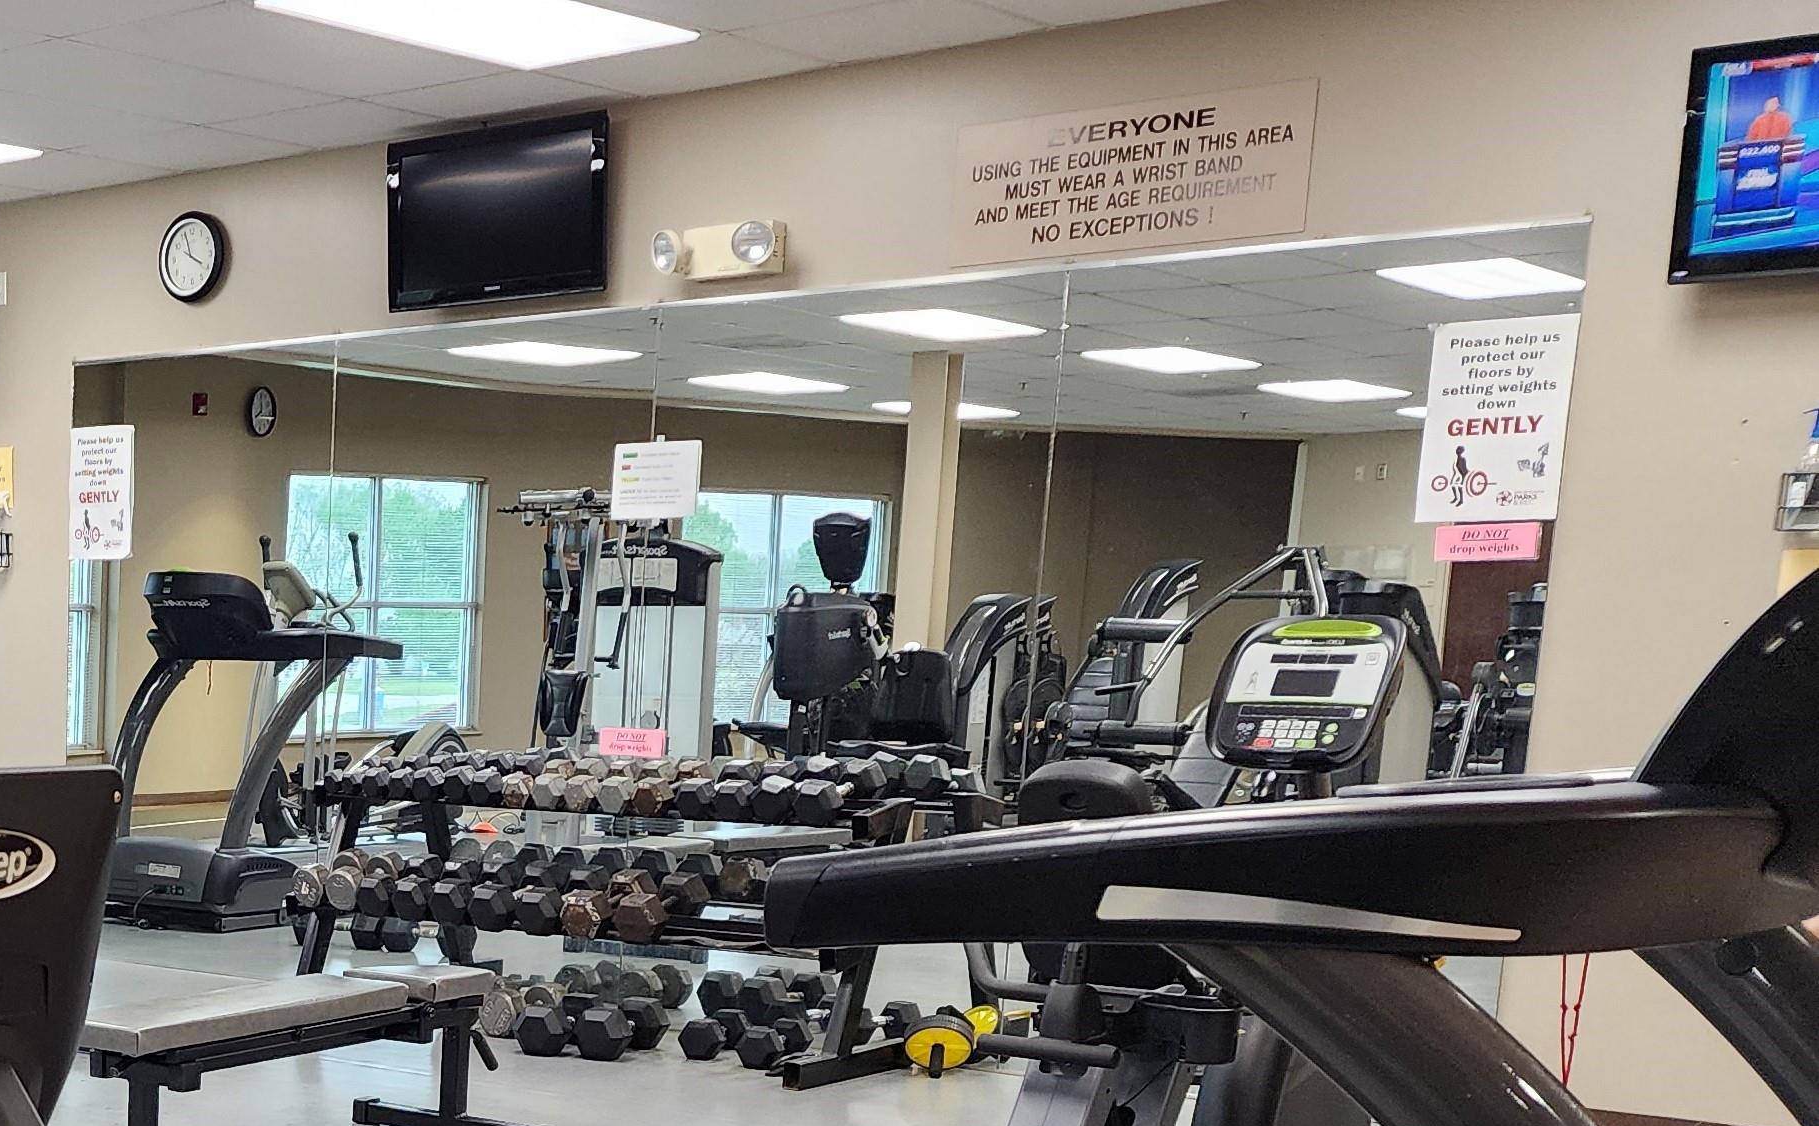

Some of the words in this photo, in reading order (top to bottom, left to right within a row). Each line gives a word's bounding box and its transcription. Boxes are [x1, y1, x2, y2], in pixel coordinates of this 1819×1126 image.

[1048, 107, 1217, 147] EVERYONE
[972, 161, 1022, 183] USING
[1029, 155, 1060, 174] THE
[1067, 141, 1165, 169] EQUIPMENT
[1173, 137, 1190, 156] IN
[1198, 132, 1238, 153] THIS
[1245, 124, 1294, 146] AREA
[1005, 179, 1049, 201] MUST
[1058, 173, 1107, 194] WEAR
[1114, 169, 1124, 187] A
[1132, 162, 1186, 184] WRIST
[1194, 155, 1243, 177] BAND
[975, 205, 1008, 225] AND
[1015, 199, 1059, 221] MEET
[1067, 195, 1098, 216] THE
[1106, 190, 1140, 210] AGE
[1148, 173, 1277, 203] REQUIREMENT
[1031, 224, 1061, 245] NO
[1069, 207, 1199, 240] EXCEPTIONS
[1450, 337, 1501, 349] Please
[1505, 333, 1538, 346] help
[1543, 333, 1561, 343] us
[1461, 350, 1515, 366] protect
[1519, 350, 1546, 361] our
[1468, 367, 1512, 379] floors
[1516, 365, 1534, 378] by
[1441, 383, 1494, 397] setting
[1498, 379, 1557, 394] weights
[1477, 399, 1517, 410] down
[1447, 414, 1544, 437] GENTLY
[79, 490, 119, 504] GENTLY
[1462, 530, 1481, 540] DO
[1484, 529, 1511, 539] NOT
[1449, 544, 1475, 555] drop
[1479, 543, 1519, 553] weights
